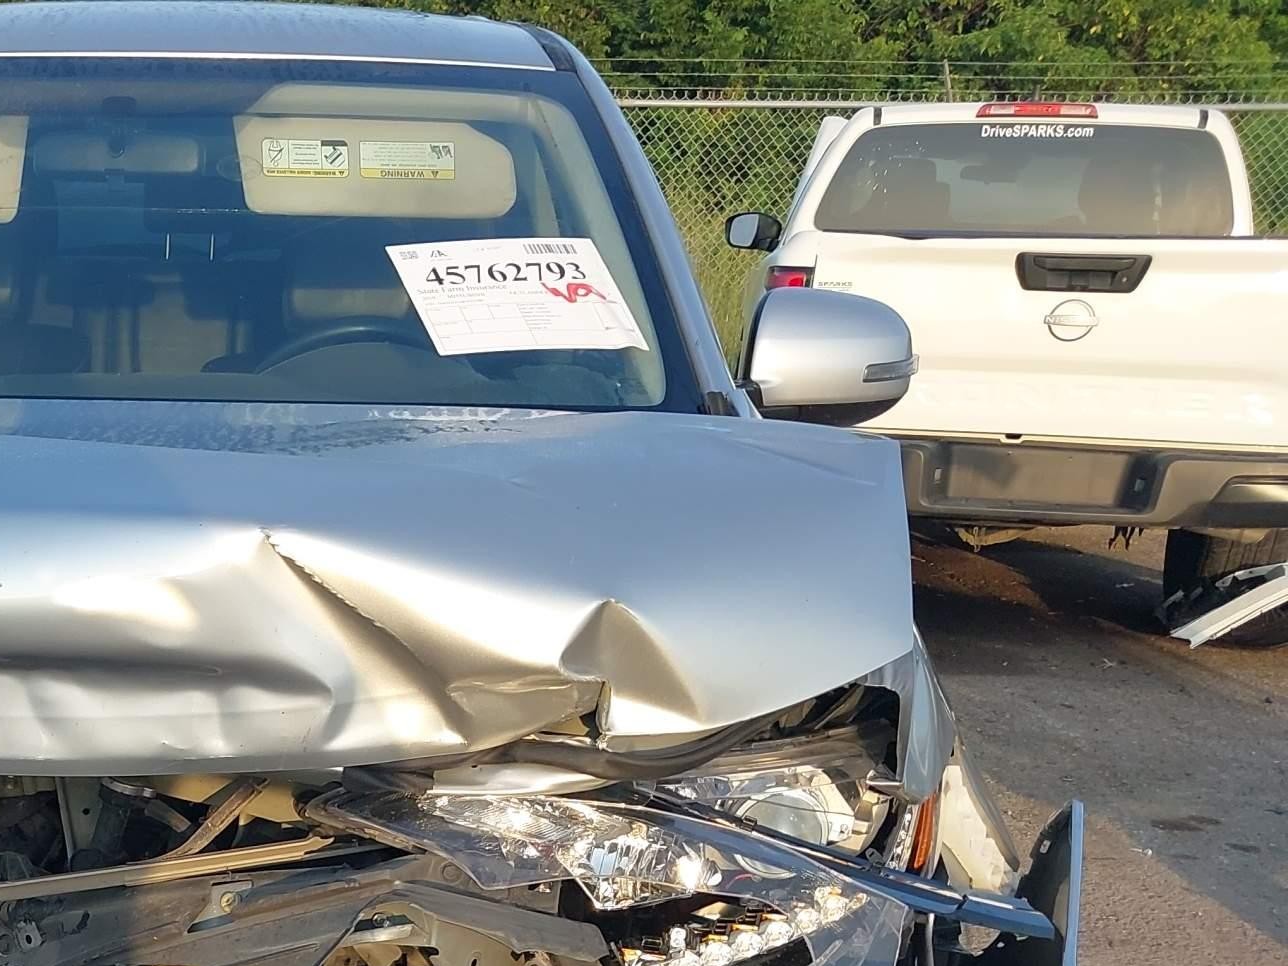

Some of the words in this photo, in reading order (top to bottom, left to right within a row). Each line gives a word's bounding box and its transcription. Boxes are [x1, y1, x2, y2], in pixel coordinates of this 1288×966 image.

[981, 125, 1094, 138] DriveSPARKS.com
[380, 170, 425, 178] WARNING
[426, 262, 586, 285] 45762793
